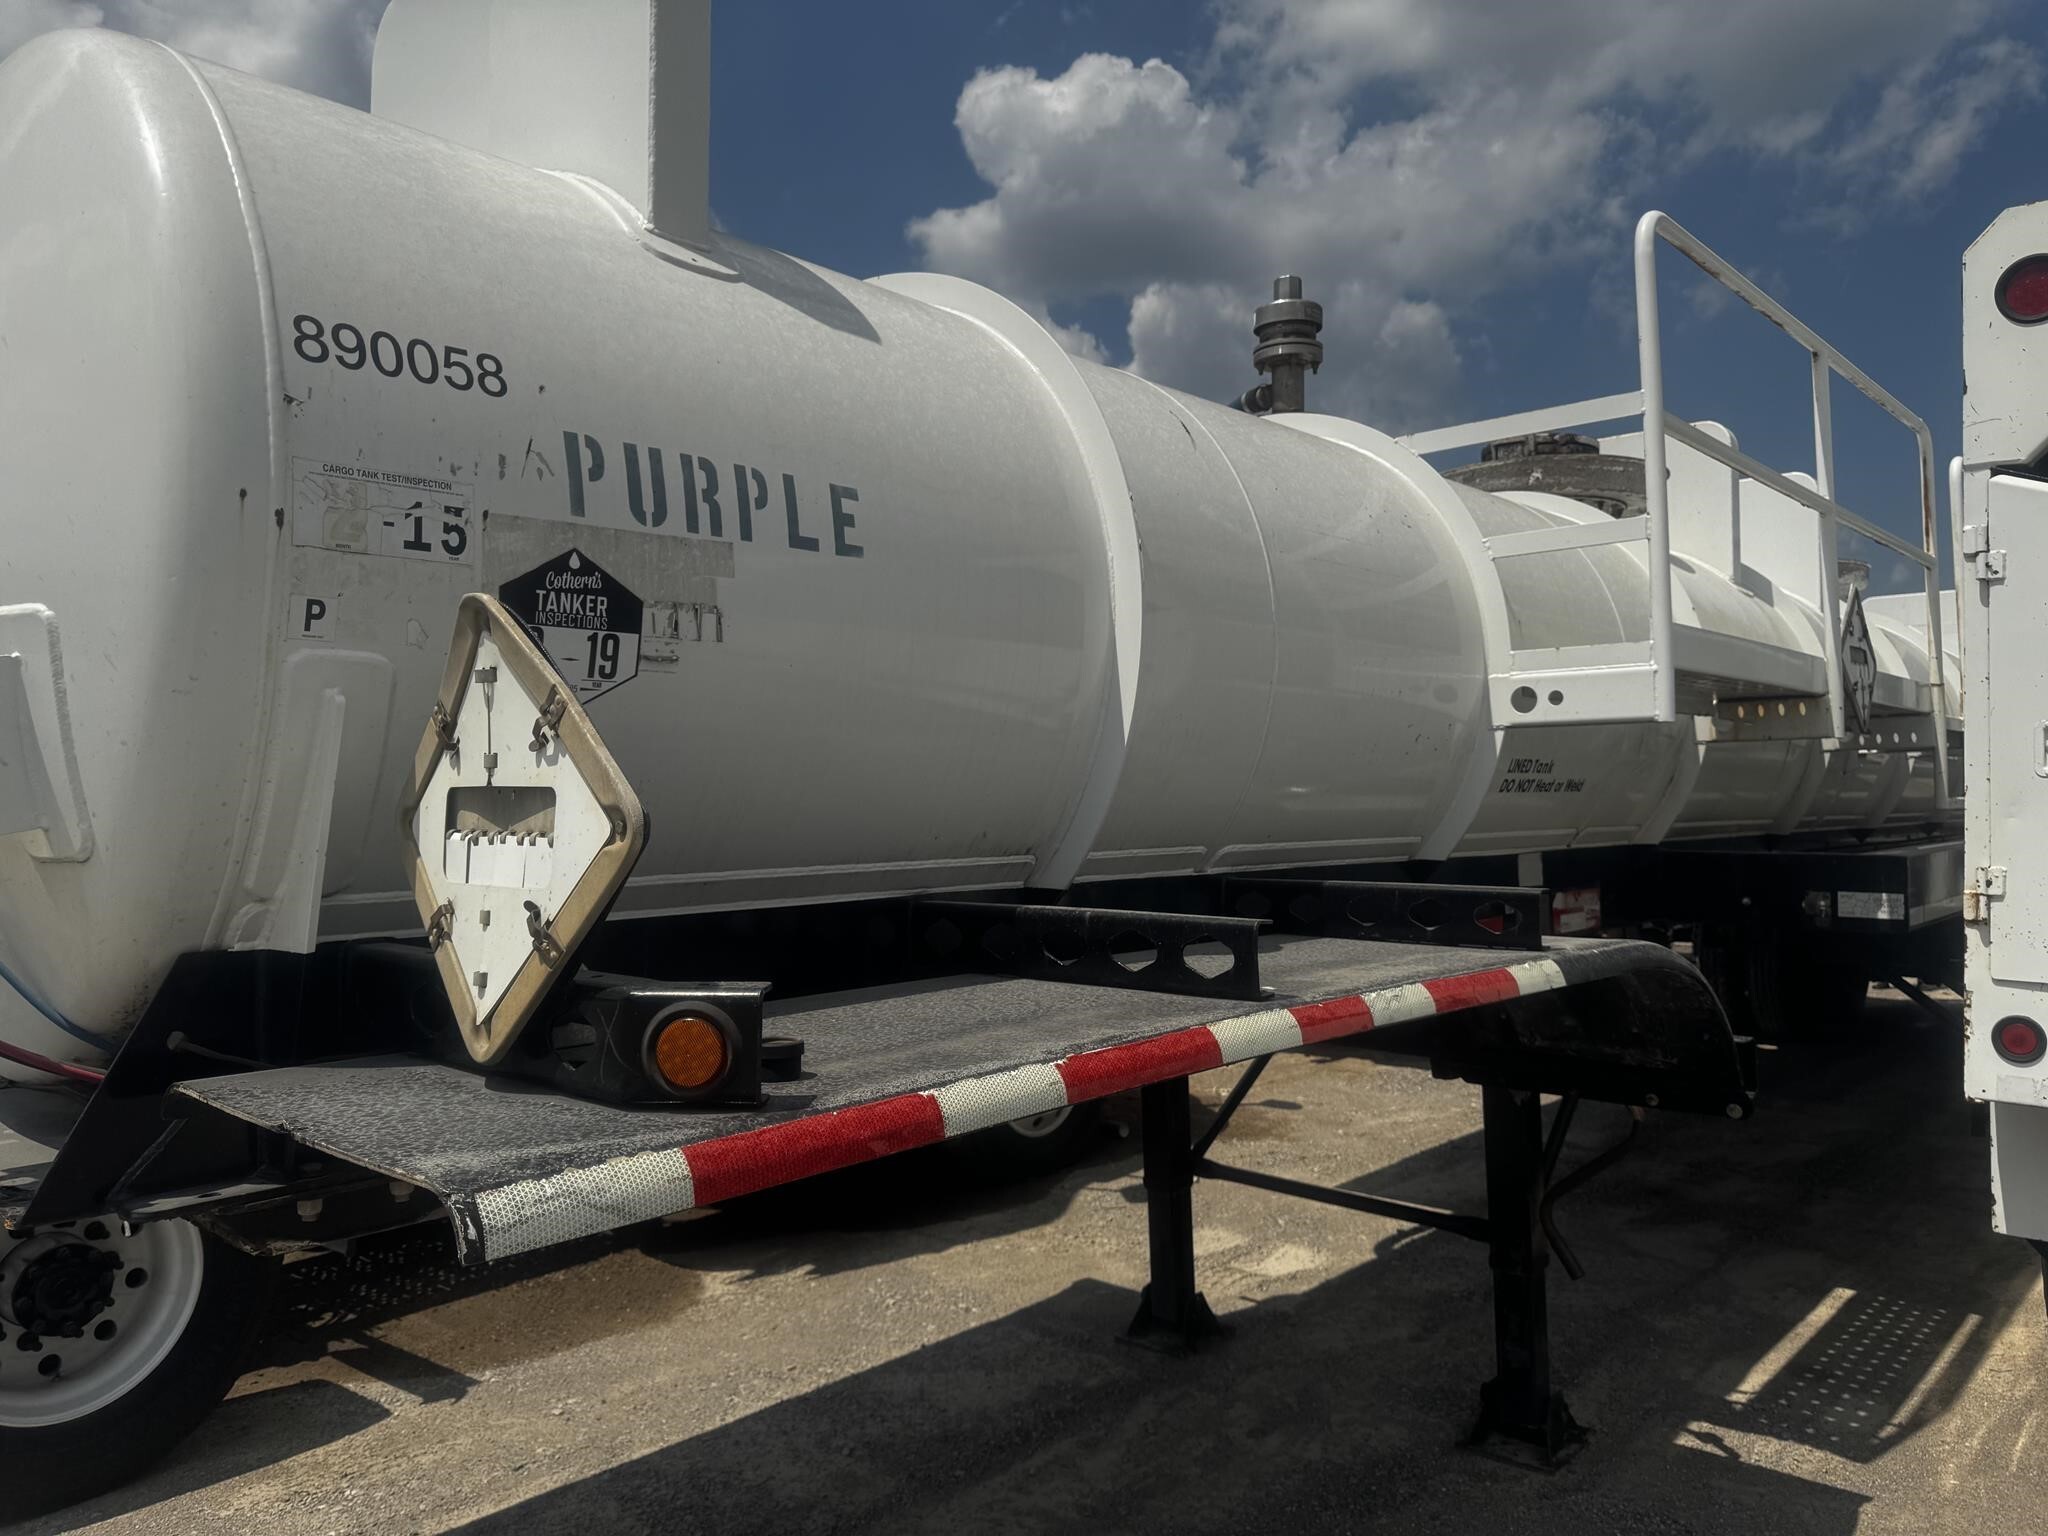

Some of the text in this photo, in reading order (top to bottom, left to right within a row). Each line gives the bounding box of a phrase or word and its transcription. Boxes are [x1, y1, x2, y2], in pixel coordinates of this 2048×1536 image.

[293, 314, 507, 397] 890058
[322, 463, 355, 477] CARGO
[356, 468, 380, 480] TANK
[382, 472, 452, 491] TEST/INSPECTION
[563, 431, 864, 557] PURPLE
[545, 571, 601, 589] Cothern's
[304, 599, 326, 632] P
[535, 589, 608, 618] TANKER
[535, 611, 608, 630] INSPECTIONS
[587, 632, 620, 679] 19
[1508, 759, 1554, 774] LINED Tank
[1499, 779, 1515, 792] DO
[1515, 779, 1535, 792] NOT
